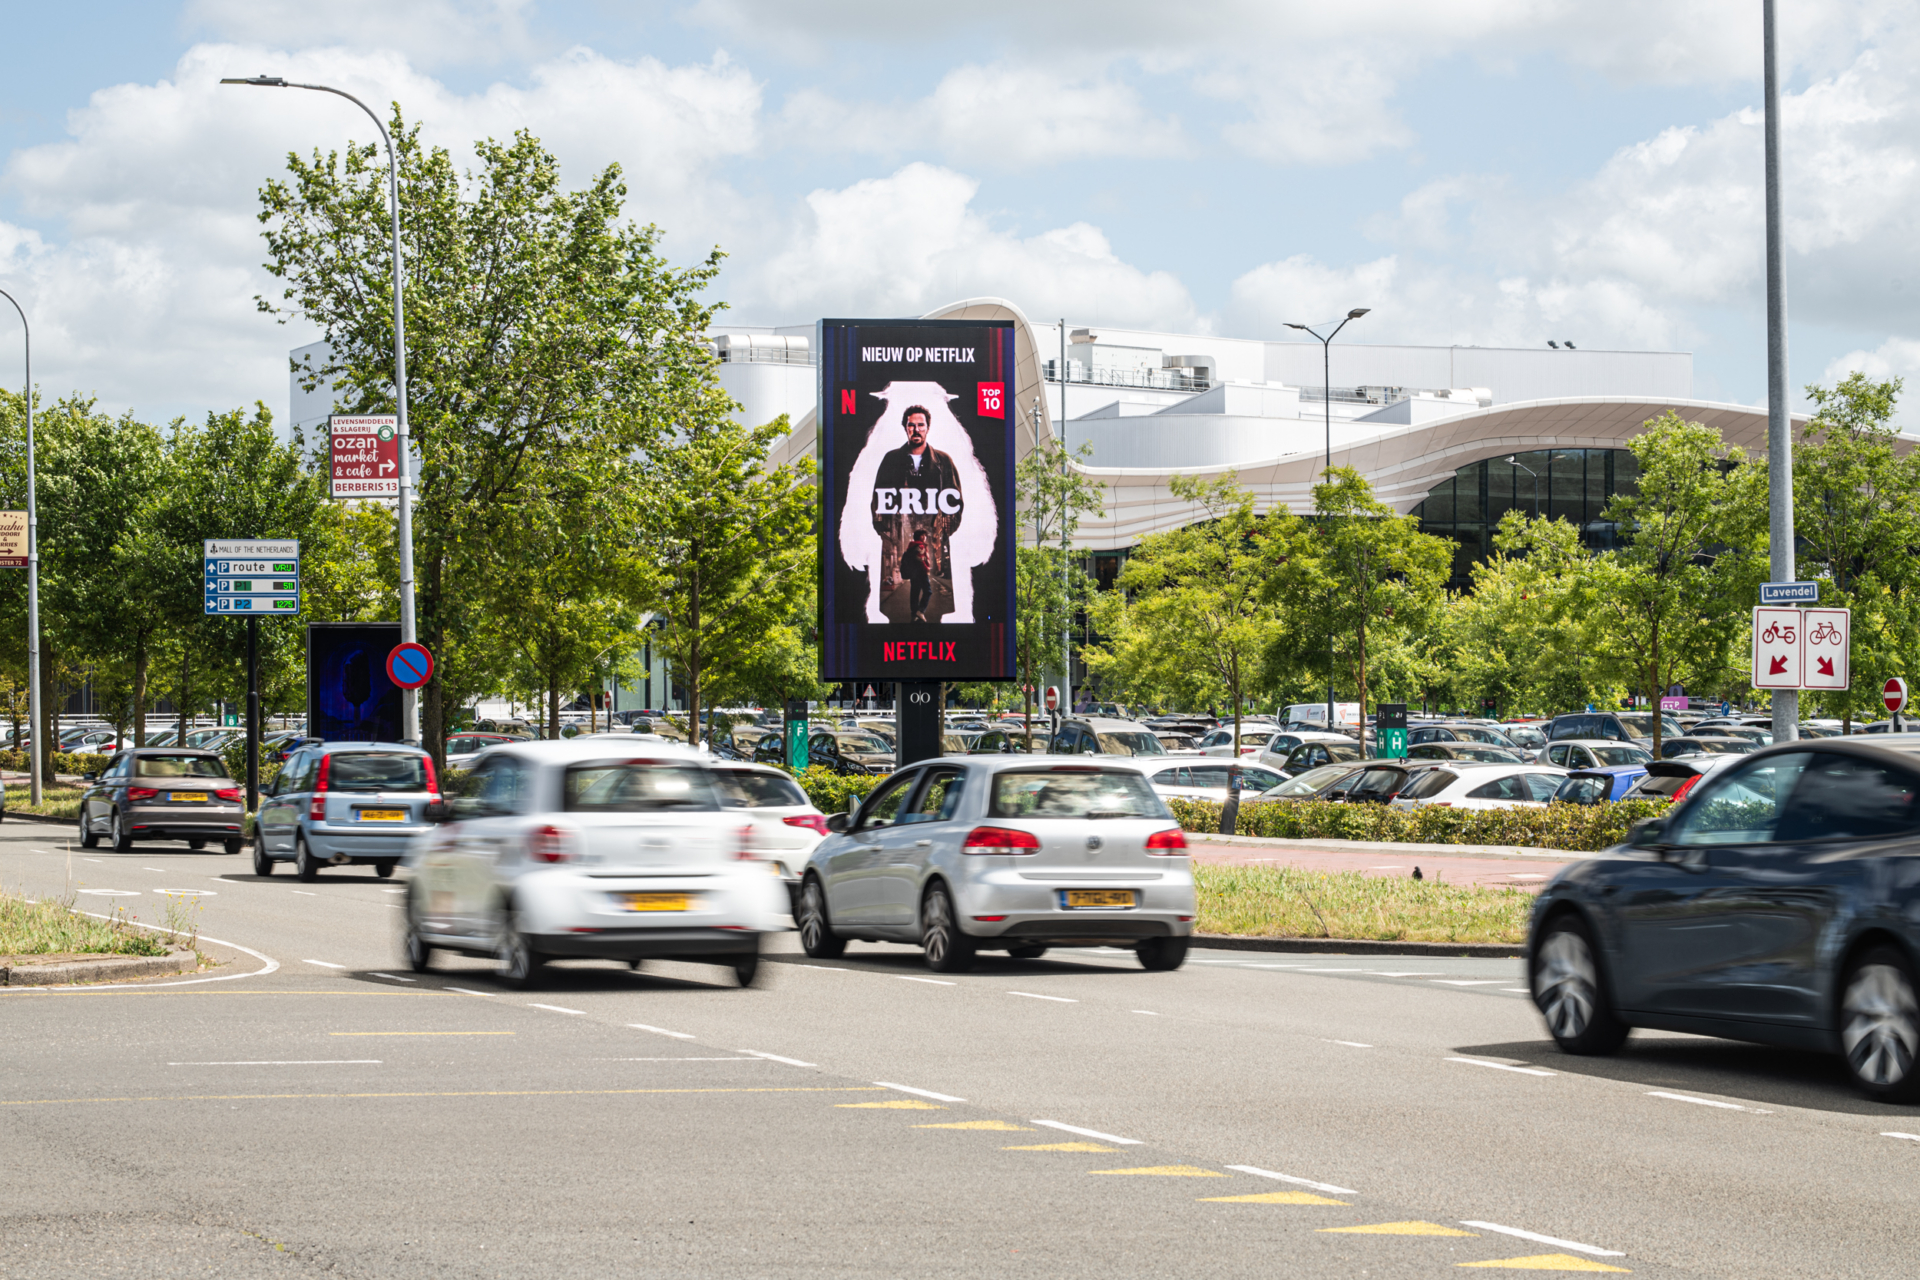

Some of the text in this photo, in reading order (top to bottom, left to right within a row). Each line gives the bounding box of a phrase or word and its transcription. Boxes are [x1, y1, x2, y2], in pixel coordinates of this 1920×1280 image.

[862, 347, 975, 363] NIEUW OP NETFLIX
[982, 389, 1001, 397] TOP
[841, 389, 856, 415] N
[983, 397, 1000, 410] 10
[334, 437, 377, 449] ozan
[334, 449, 379, 463] market
[335, 464, 372, 478] & cafe
[335, 482, 398, 492] BERBERIS 13
[875, 488, 961, 515] ERIC
[221, 563, 228, 573] P
[233, 562, 265, 572] route
[221, 581, 228, 591] P
[235, 581, 247, 591] P1
[1765, 586, 1813, 598] Lavendel
[221, 599, 228, 609] P
[235, 599, 251, 609] P2
[884, 641, 956, 662] NETFLIX
[797, 727, 803, 737] F
[1392, 737, 1401, 750] H
